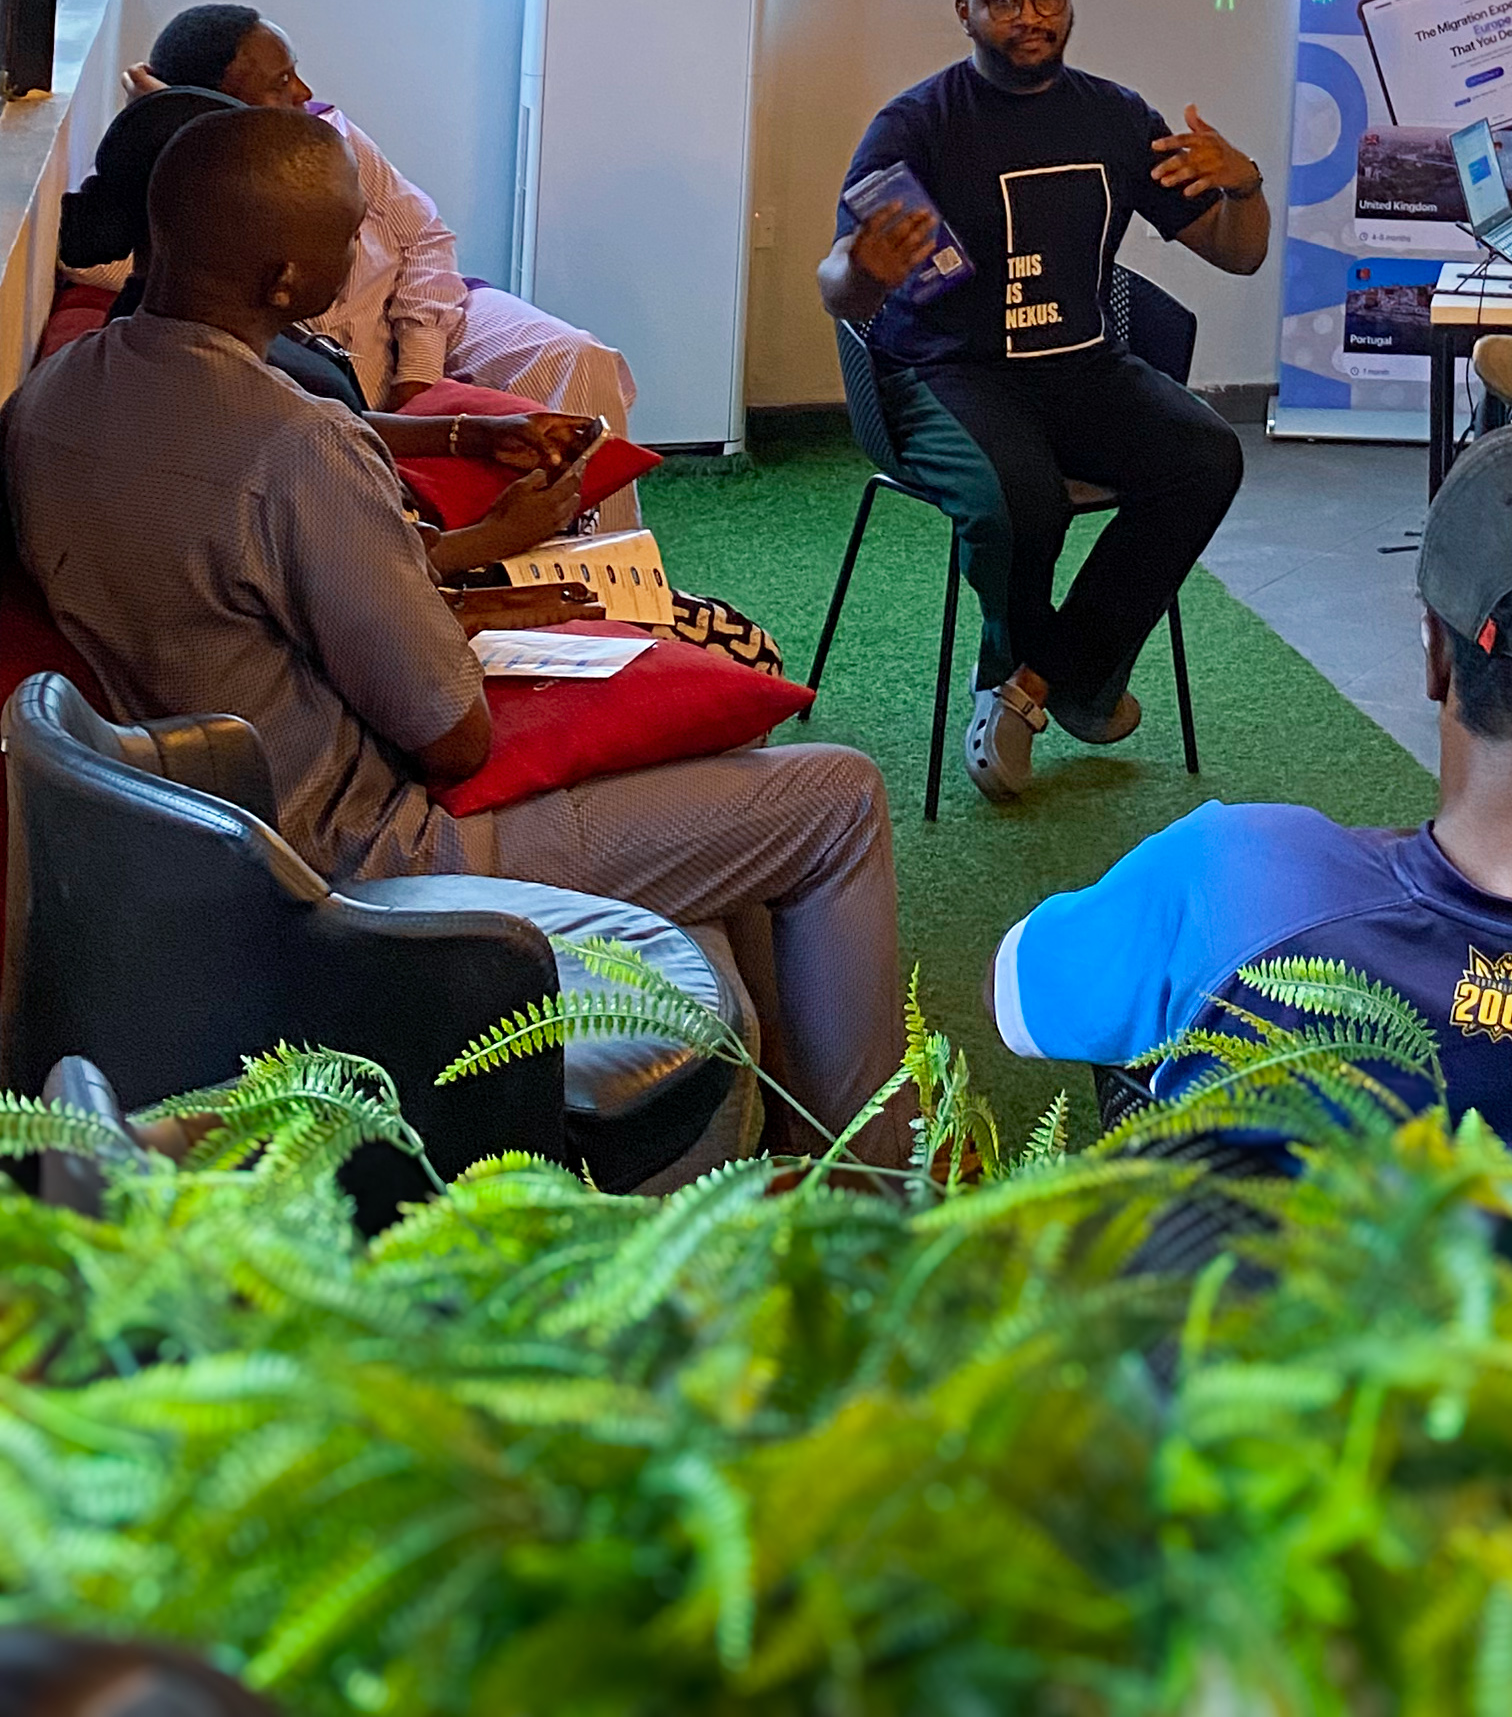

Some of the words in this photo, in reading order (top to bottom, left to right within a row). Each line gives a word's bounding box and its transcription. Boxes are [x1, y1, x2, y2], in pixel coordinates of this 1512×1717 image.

[1414, 28, 1437, 43] The
[1437, 10, 1489, 37] Migration
[1473, 15, 1512, 36] Europe
[1450, 42, 1477, 58] That
[1476, 35, 1497, 49] You
[1358, 200, 1392, 212] United
[1393, 201, 1438, 213] Kingdom
[1007, 253, 1043, 279] THIS
[1005, 283, 1023, 304] IS
[1005, 303, 1063, 330] NEXUS.
[1350, 334, 1392, 347] Portugal
